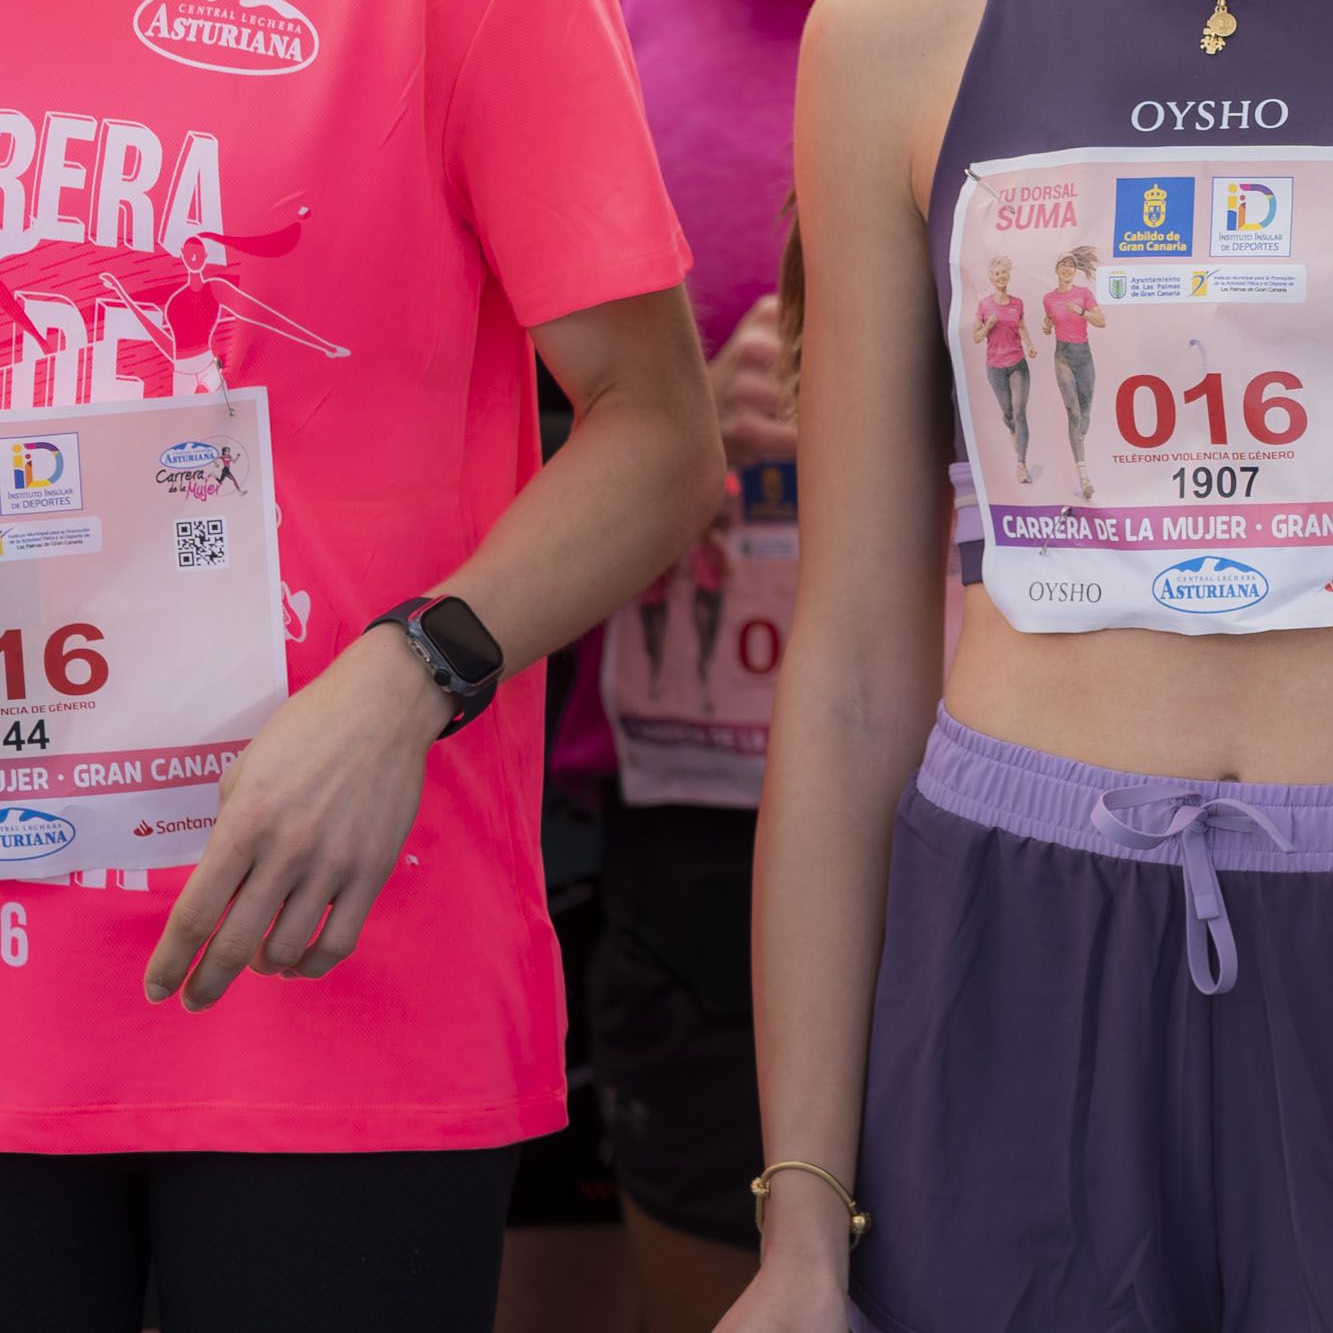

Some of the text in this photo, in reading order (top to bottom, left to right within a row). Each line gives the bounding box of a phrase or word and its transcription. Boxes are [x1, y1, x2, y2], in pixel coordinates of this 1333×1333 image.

[178, 3, 303, 34] CENTRAL LECHERA
[144, 3, 304, 62] ASTURIANA
[1131, 98, 1290, 133] OYSHO
[1020, 182, 1079, 202] DORSAL
[995, 202, 1079, 232] SUMA
[1119, 242, 1188, 253] Gran Canaria
[1123, 231, 1181, 242] Cabildo de
[1232, 242, 1280, 252] DEPORTES
[1131, 276, 1181, 284] Ayuntamiento
[1115, 370, 1309, 449] 016
[165, 453, 215, 464] ASTURIANA
[1112, 450, 1295, 464] TELÉFONO VIOLENCIA DE GÉNERO
[156, 469, 205, 484] Carrera
[1172, 466, 1260, 499] 1907
[186, 481, 222, 502] Mujer
[23, 497, 71, 509] DEPORTES
[1002, 515, 1093, 541] CARRERA
[1094, 518, 1119, 542] DE
[1125, 518, 1154, 542] LA
[1163, 516, 1247, 541] MUJER
[1028, 581, 1102, 604] OYSHO
[1160, 578, 1260, 600] ASTURIANA
[0, 623, 109, 701] 16
[31, 705, 46, 714] DE
[48, 701, 96, 713] GÉNERO
[3, 719, 50, 752] 44
[73, 761, 142, 789] GRAN
[1, 902, 29, 968] 6
